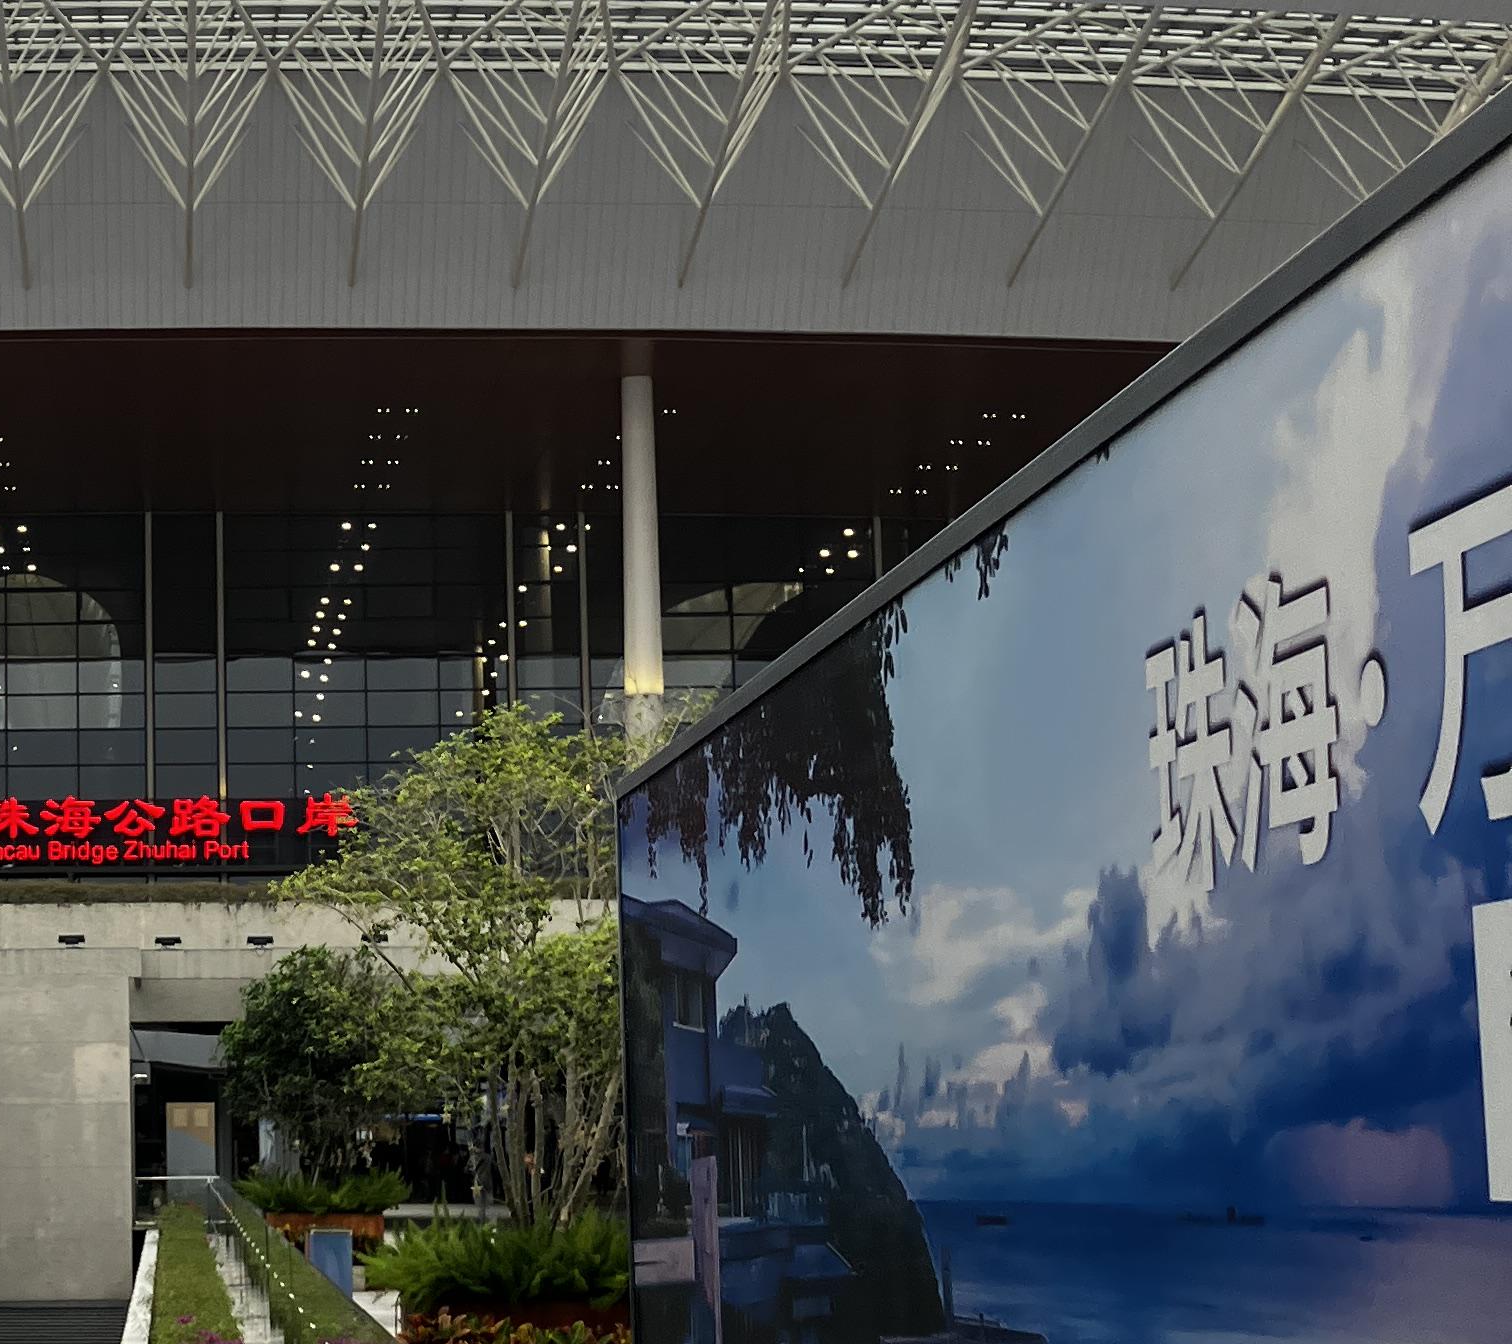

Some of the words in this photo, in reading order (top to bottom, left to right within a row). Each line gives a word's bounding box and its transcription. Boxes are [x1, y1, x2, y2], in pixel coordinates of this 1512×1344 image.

[48, 840, 119, 865] Bridge
[124, 840, 197, 861] Zhuhai
[204, 840, 250, 860] Port
